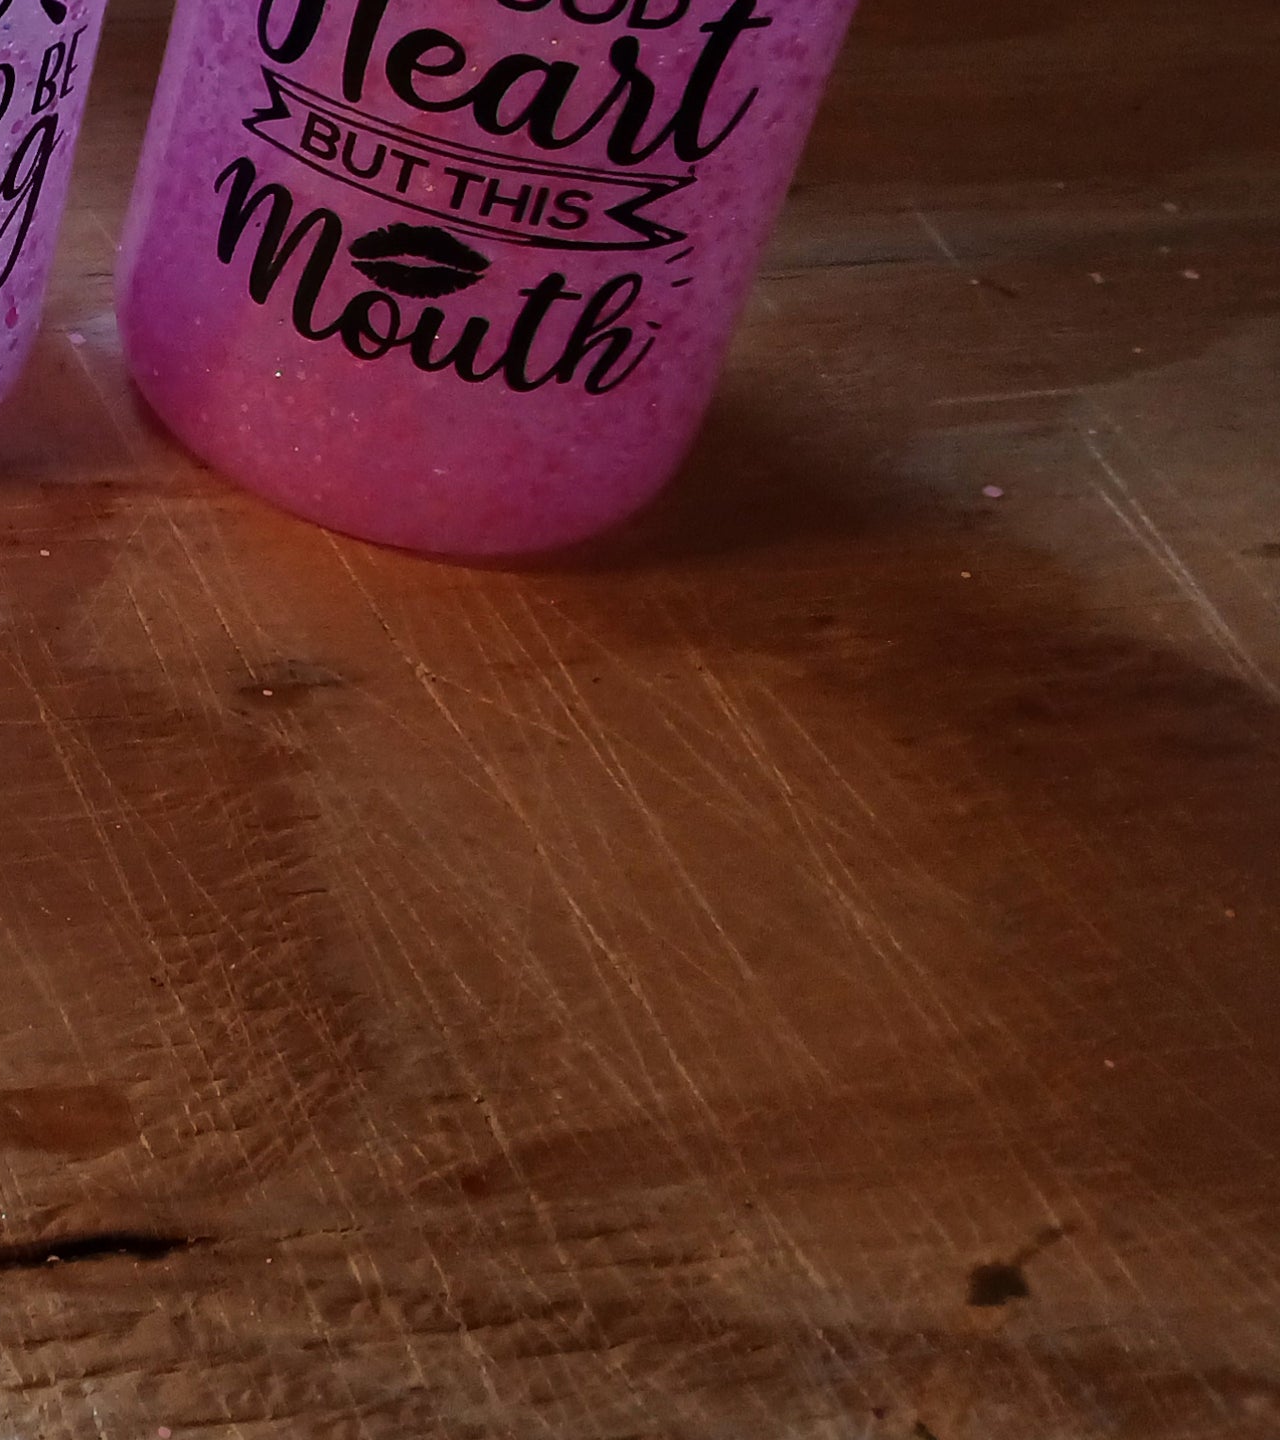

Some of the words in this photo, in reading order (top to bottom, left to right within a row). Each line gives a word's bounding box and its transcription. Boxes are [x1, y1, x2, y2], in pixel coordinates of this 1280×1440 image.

[31, 26, 88, 116] BE
[300, 112, 429, 194] BUT
[443, 166, 595, 231] THIS
[214, 156, 659, 395] Mouth
